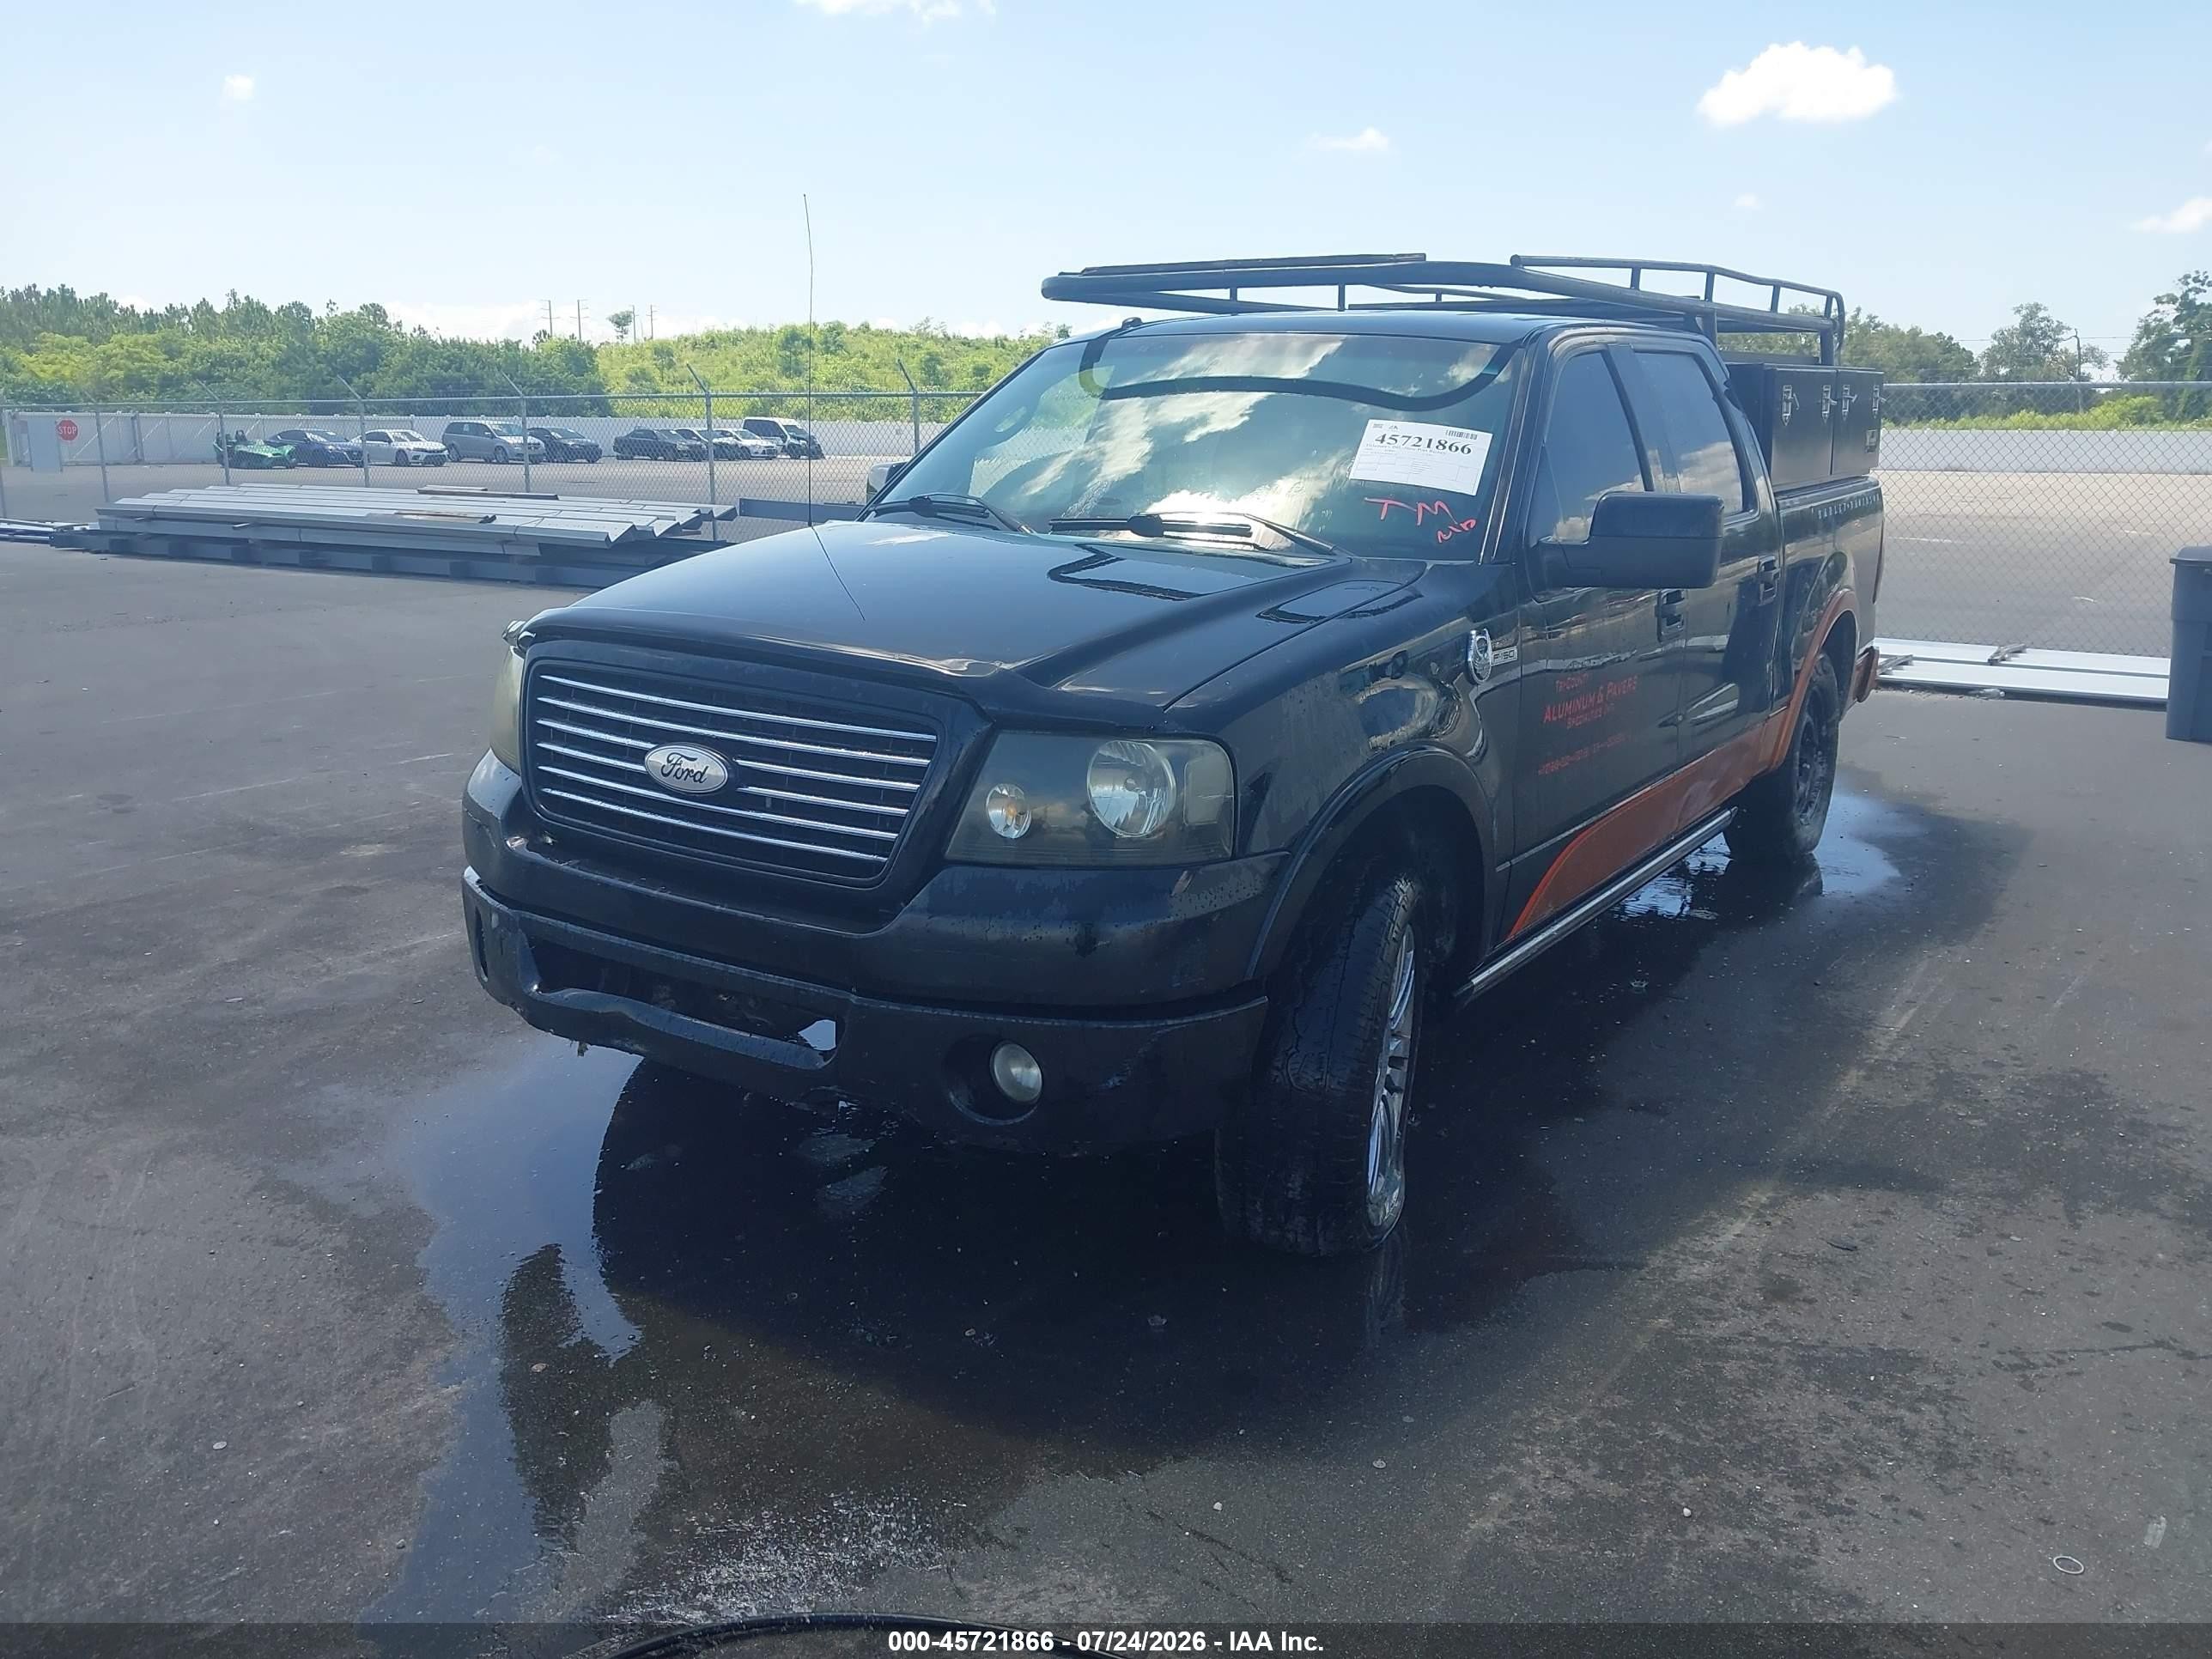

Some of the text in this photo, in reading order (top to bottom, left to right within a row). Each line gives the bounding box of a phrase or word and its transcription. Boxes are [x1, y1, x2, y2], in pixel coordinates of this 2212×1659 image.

[58, 426, 76, 434] STOP
[1375, 432, 1472, 455] 45721866
[1493, 648, 1515, 663] F-150
[1543, 694, 1596, 723] ALUMINUM
[1607, 675, 1637, 701] PAVERS
[660, 751, 709, 784] Ford
